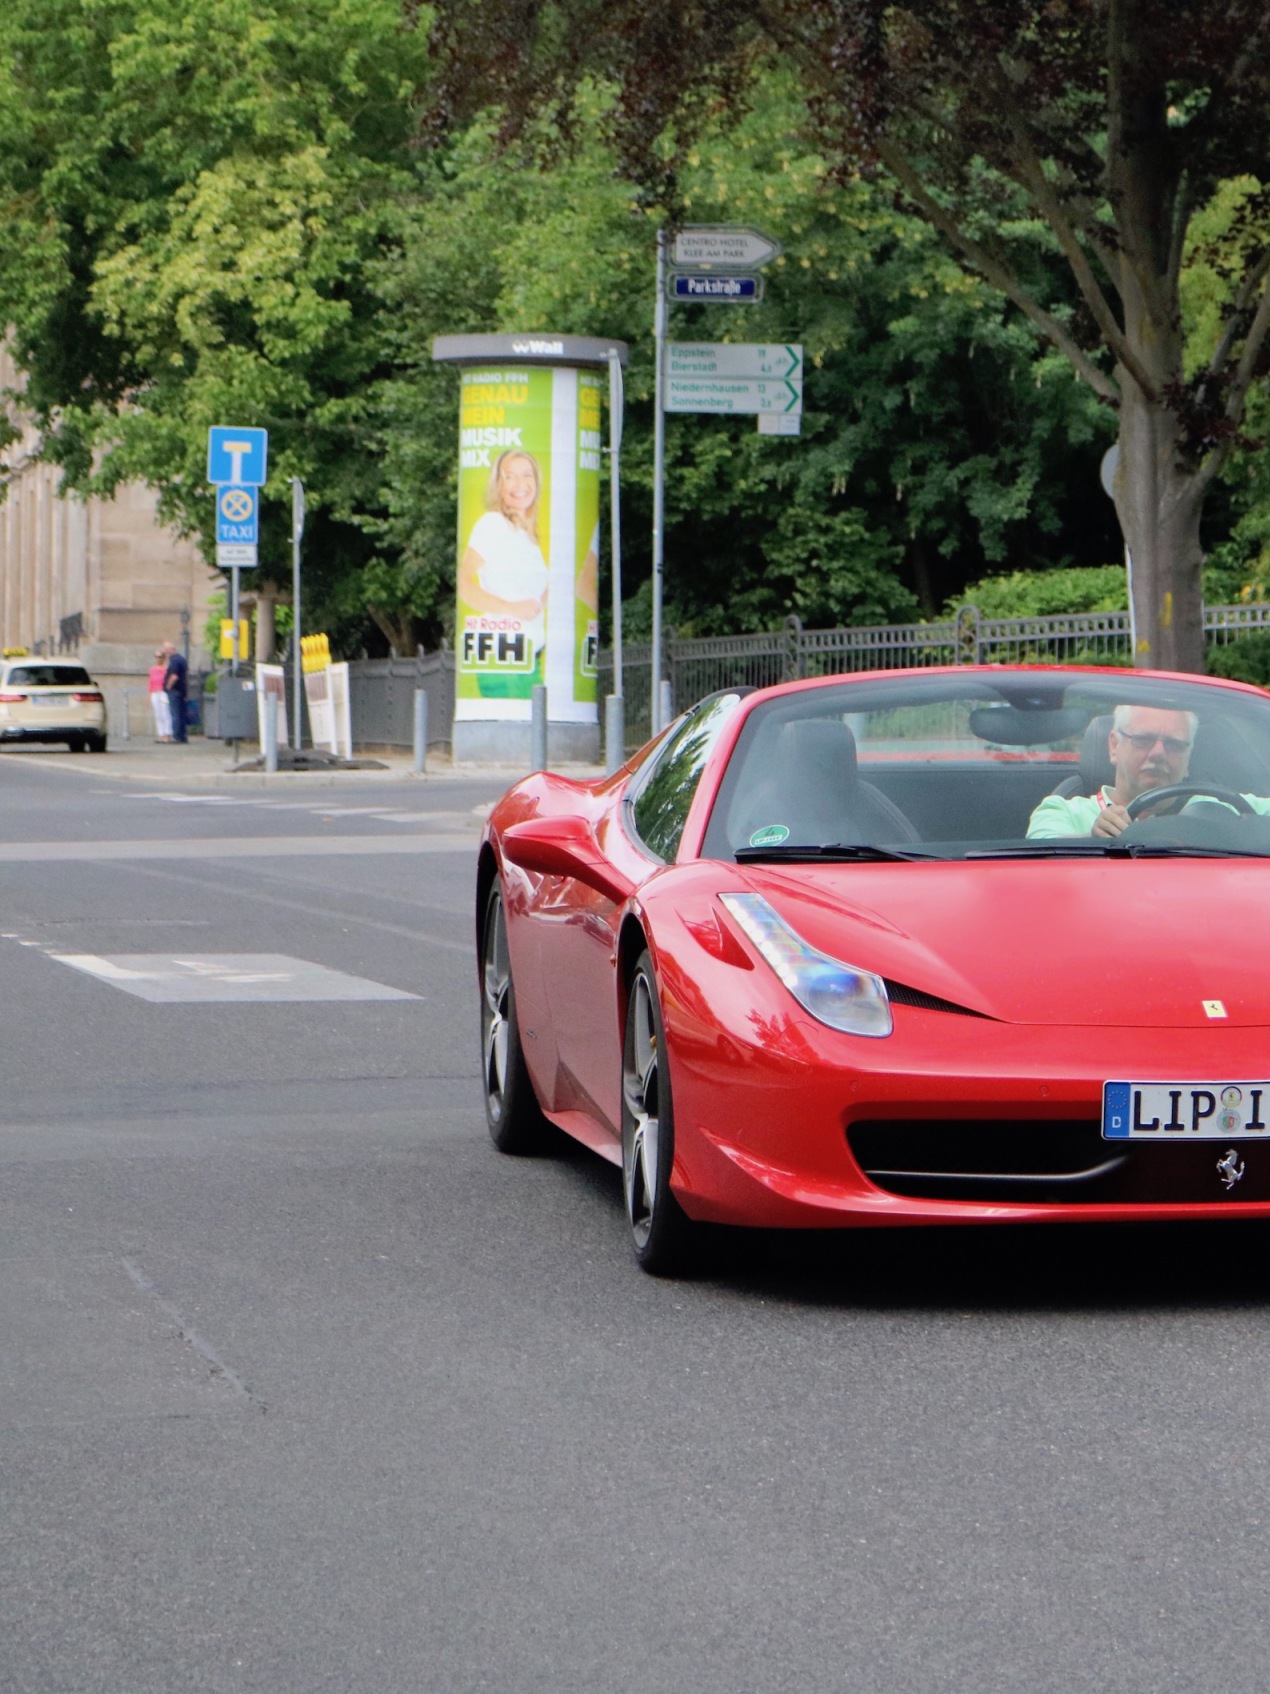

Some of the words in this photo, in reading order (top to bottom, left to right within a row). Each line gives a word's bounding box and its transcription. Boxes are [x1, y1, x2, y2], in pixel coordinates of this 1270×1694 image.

[681, 238, 717, 246] CENTRO
[720, 238, 749, 246] HOTEL
[706, 250, 721, 258] AM
[723, 250, 745, 258] PARK
[688, 279, 742, 296] Parkstraße
[530, 340, 564, 355] Wall
[671, 348, 715, 359] Eppstein
[671, 360, 717, 371] Bierstadt
[505, 372, 529, 384] FFH
[463, 384, 529, 404] GENAU
[671, 382, 749, 393] Niedernhausen
[671, 396, 733, 409] Sonnenberg
[462, 427, 523, 448] MUSIK
[462, 449, 492, 468] MIX
[220, 524, 253, 539] TAXI
[480, 617, 521, 631] Radio
[464, 633, 525, 662] FFH
[1111, 1116, 1122, 1129] D
